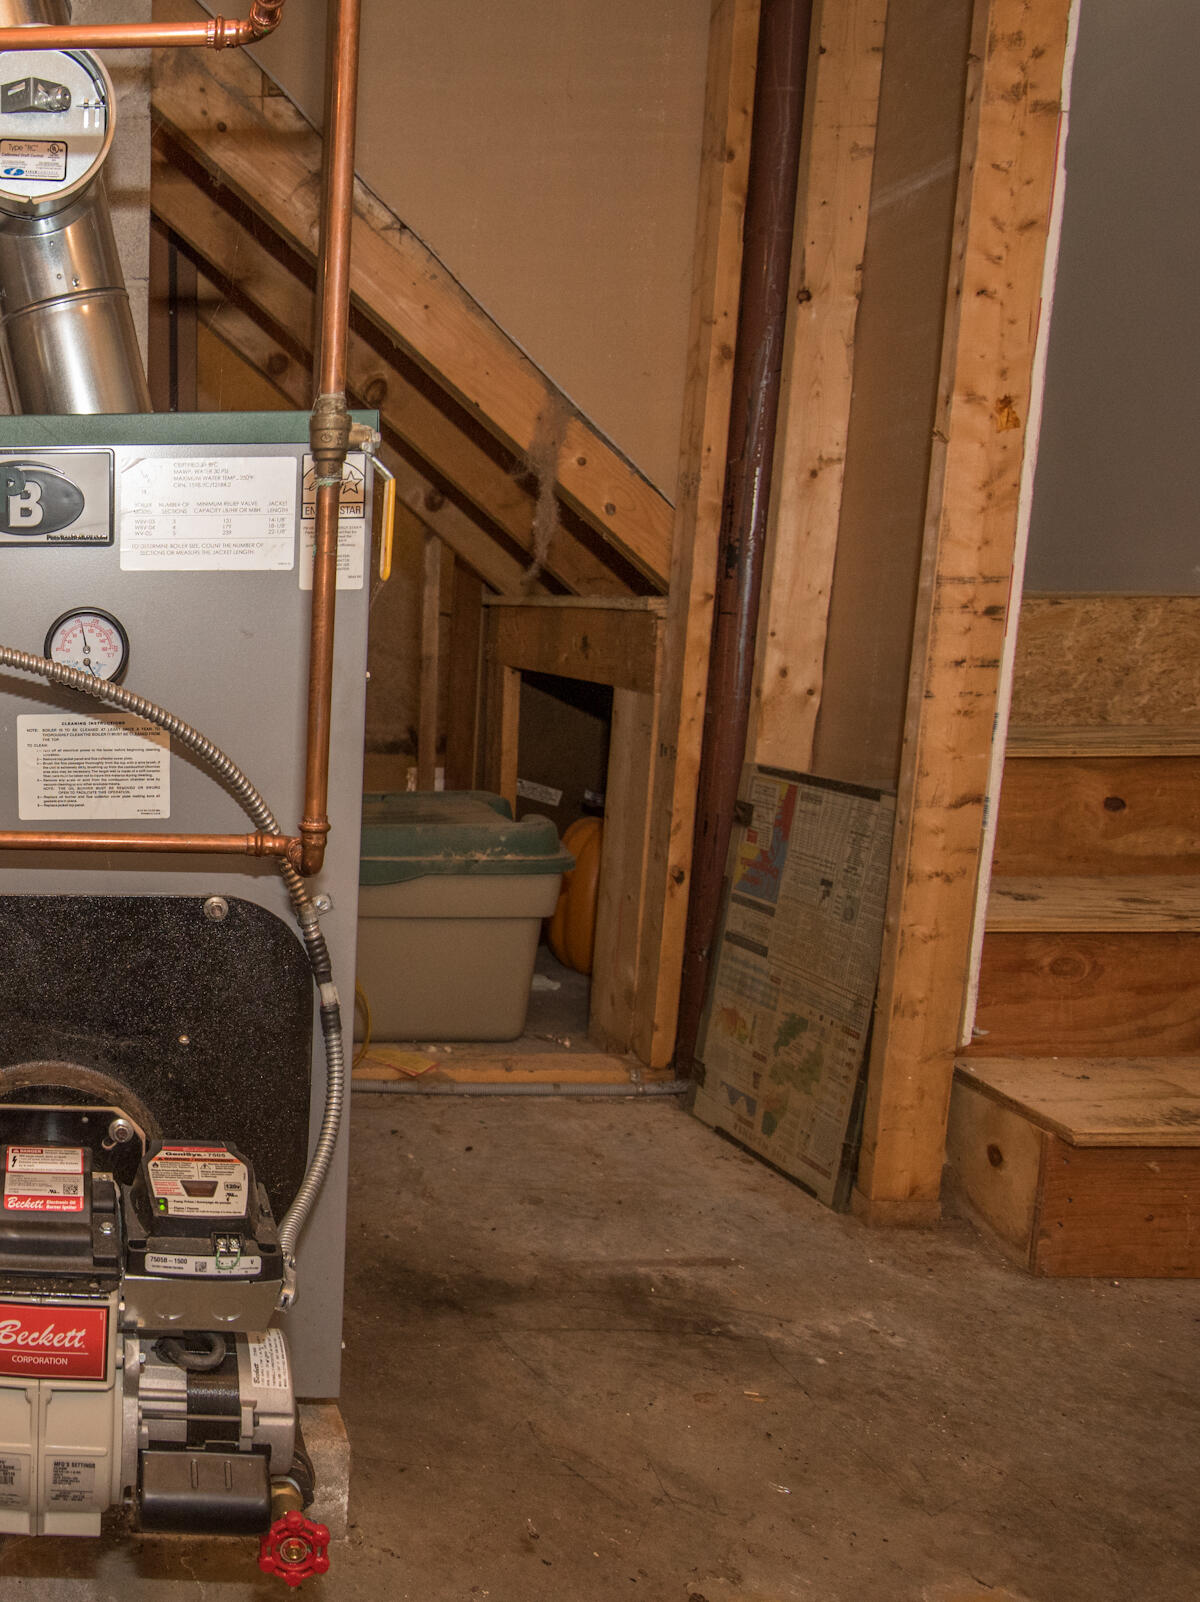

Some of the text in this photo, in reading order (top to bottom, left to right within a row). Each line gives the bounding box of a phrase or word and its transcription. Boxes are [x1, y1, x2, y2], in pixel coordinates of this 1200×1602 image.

[340, 506, 361, 515] STAR
[6, 1196, 44, 1208] Beckett
[11, 1354, 68, 1365] CORPORATION
